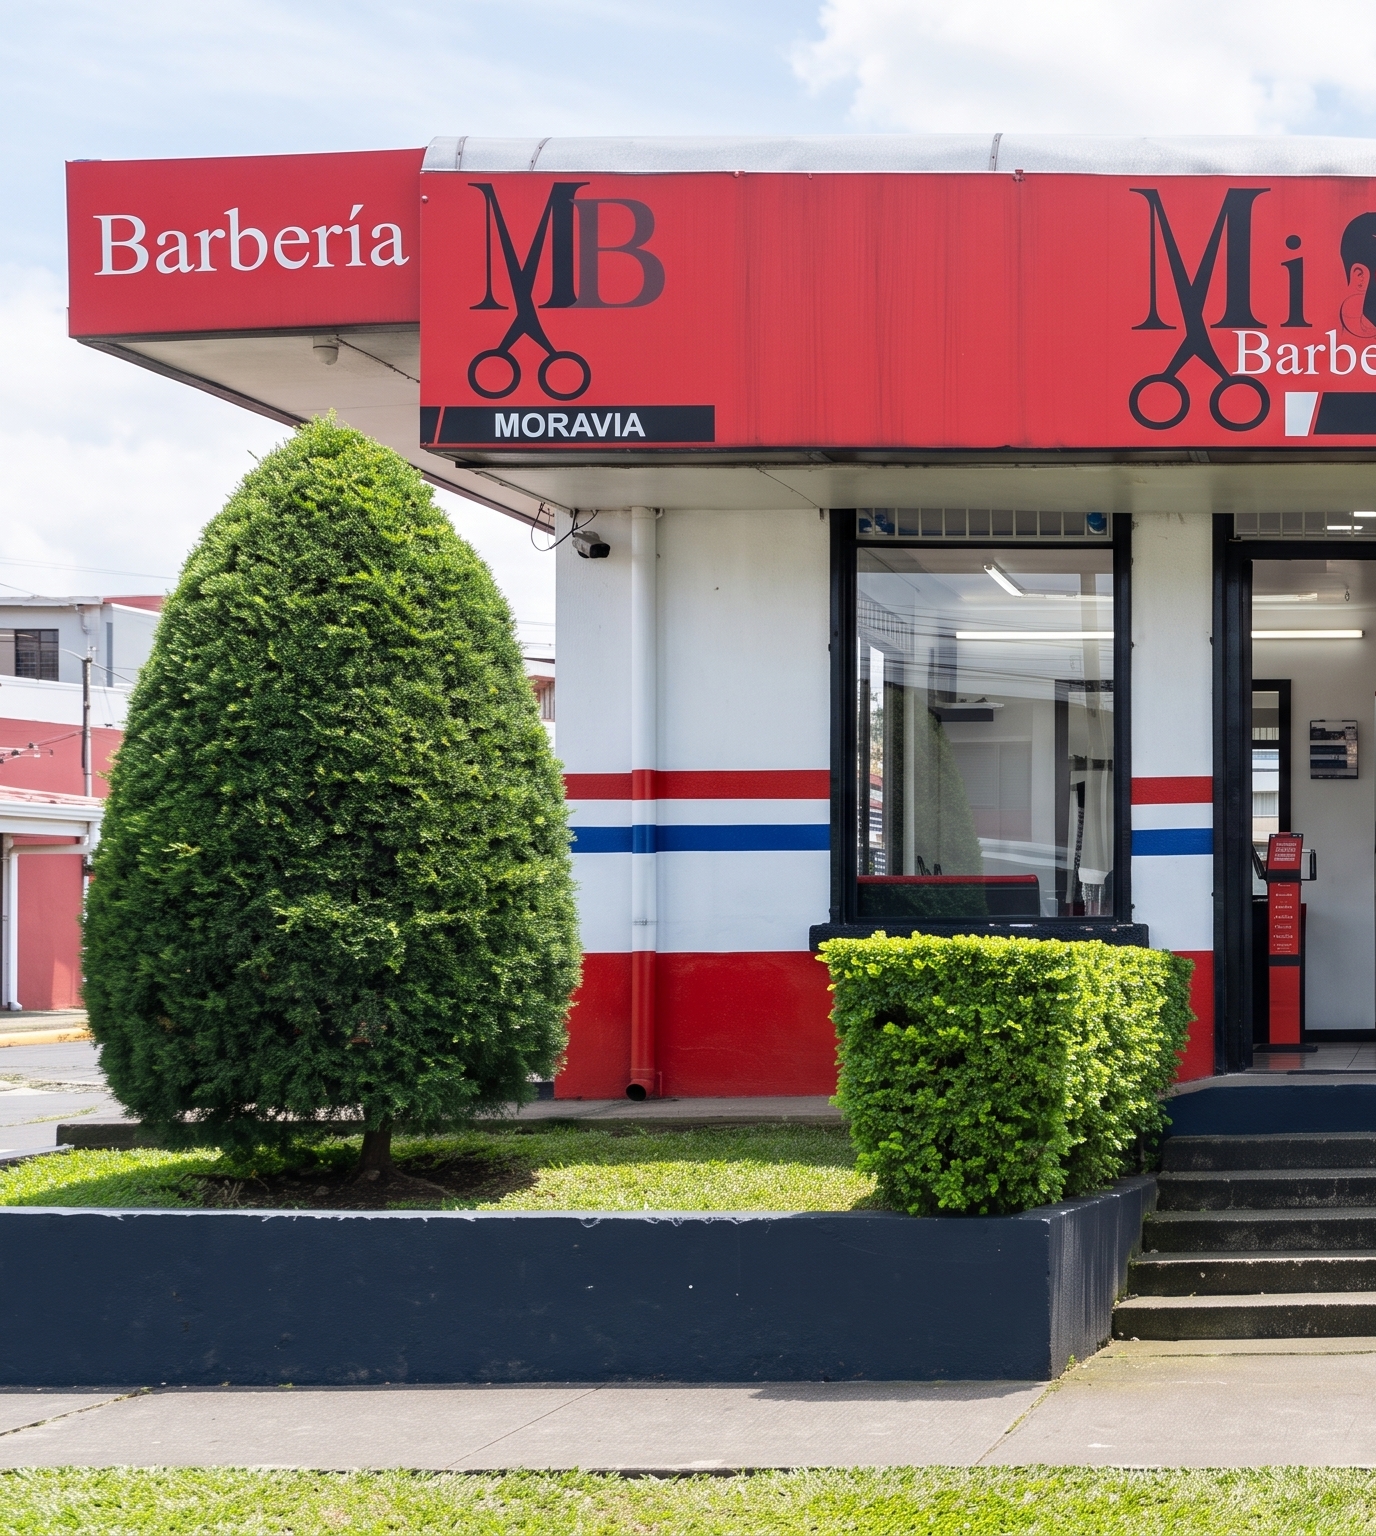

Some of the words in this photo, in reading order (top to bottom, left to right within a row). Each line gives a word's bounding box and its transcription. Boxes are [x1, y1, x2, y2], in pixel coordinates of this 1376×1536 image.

[92, 203, 410, 276] Barbería
[467, 181, 666, 310] MB
[1129, 187, 1314, 330] Mi
[494, 412, 646, 438] MORAVIA
